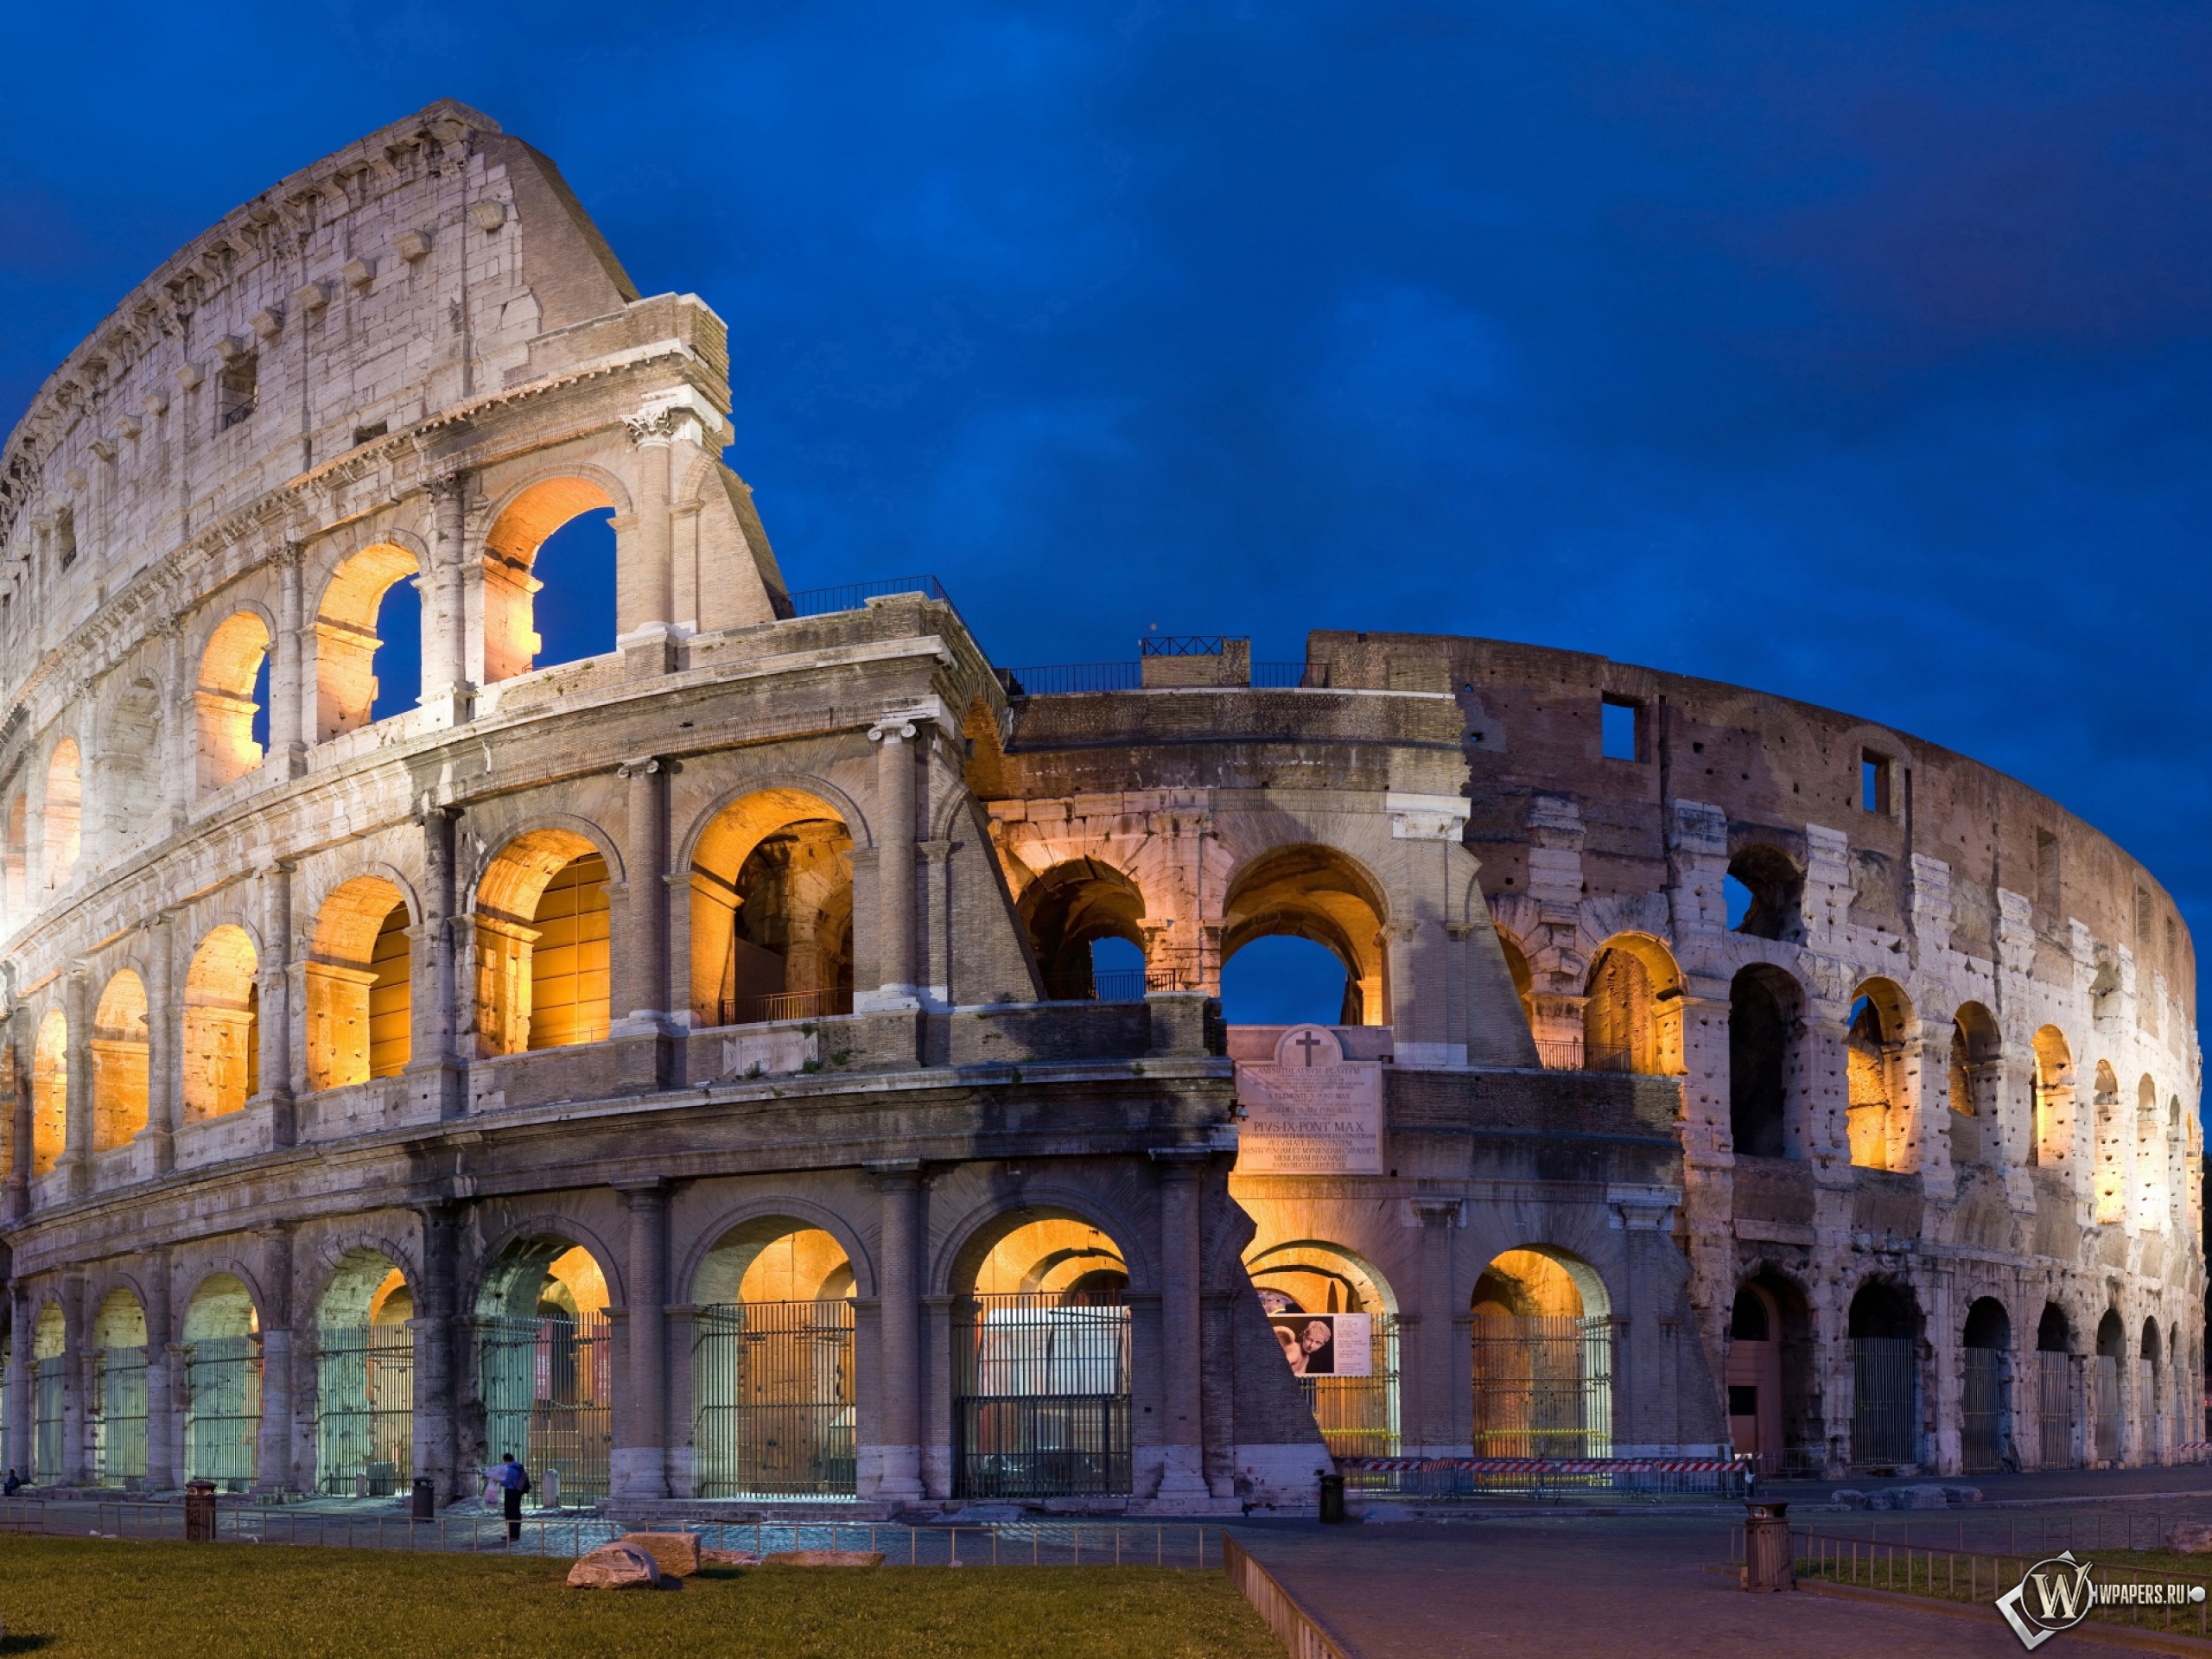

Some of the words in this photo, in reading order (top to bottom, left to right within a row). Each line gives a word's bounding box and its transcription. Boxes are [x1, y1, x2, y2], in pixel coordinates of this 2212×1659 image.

[1254, 1122, 1280, 1132] PIVS
[1282, 1122, 1296, 1132] IX
[1299, 1122, 1331, 1132] PONT
[1334, 1122, 1365, 1132] MAX
